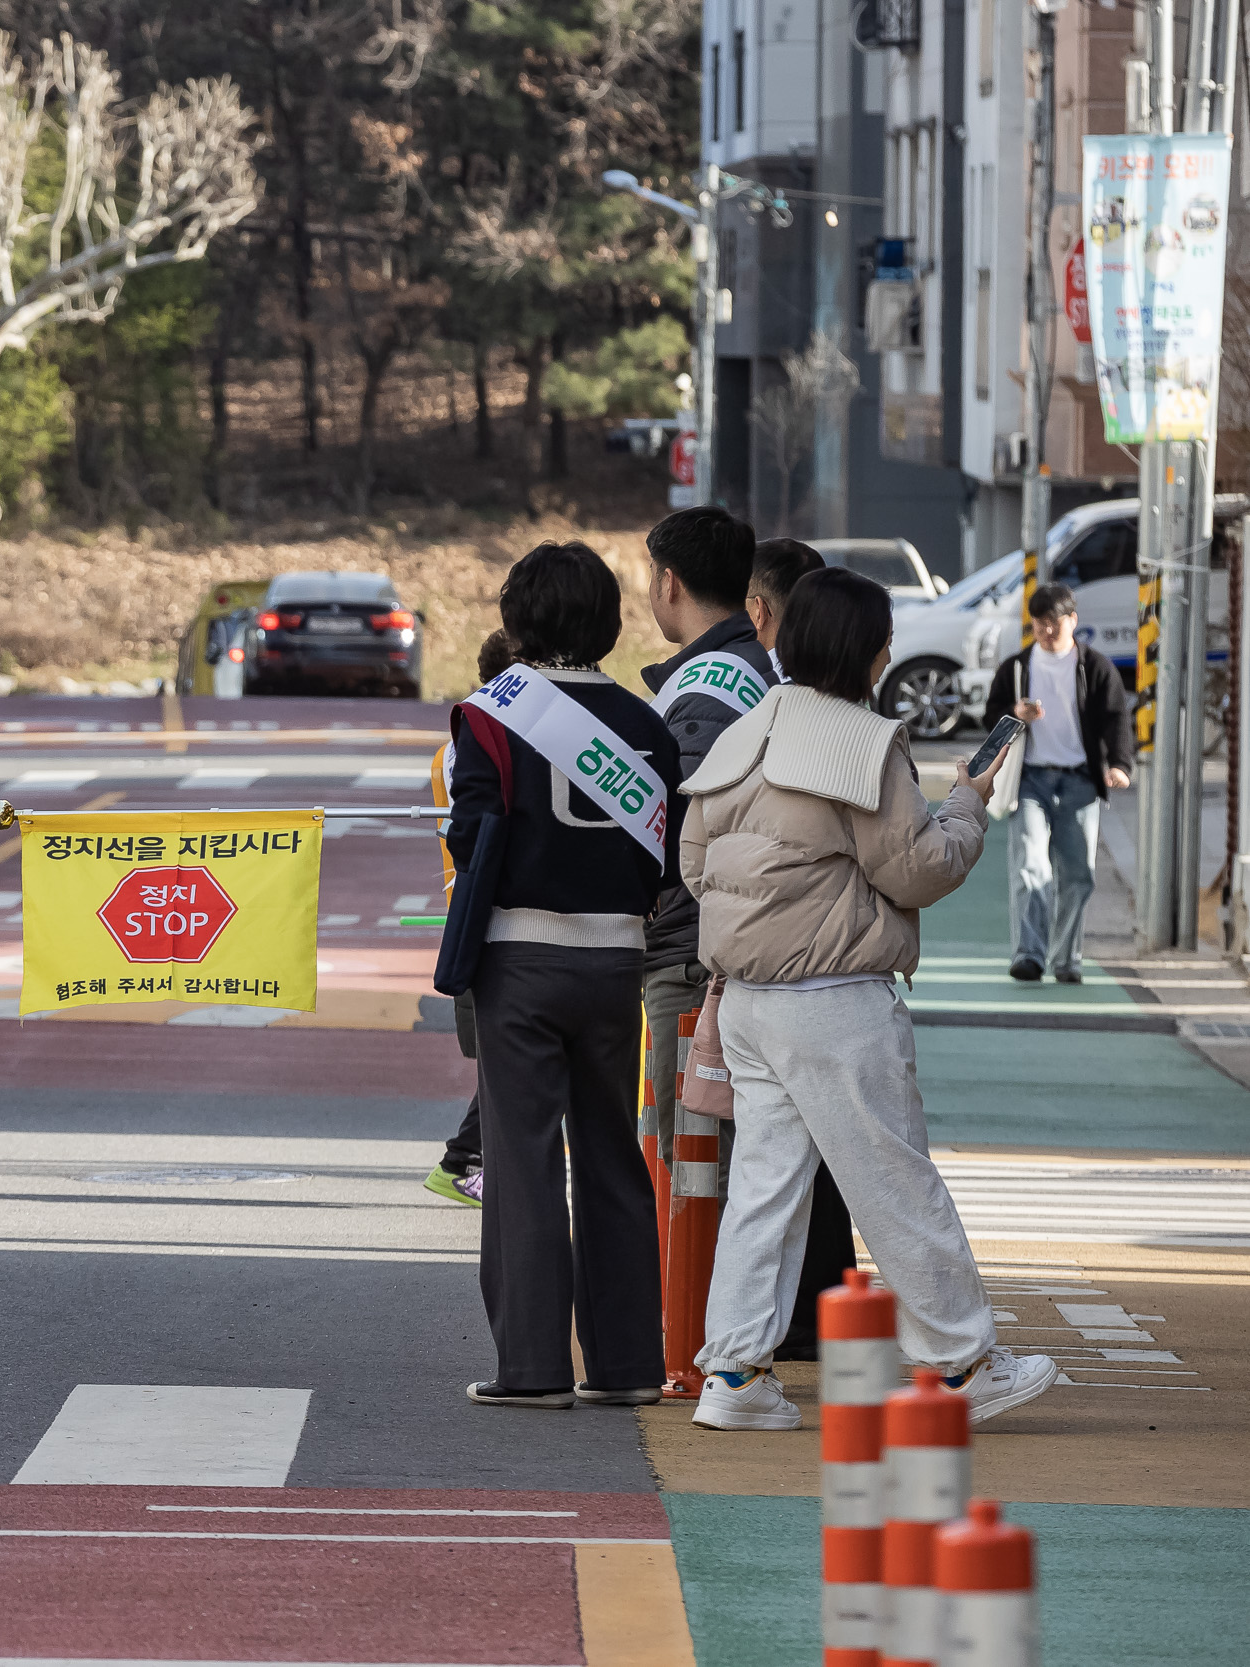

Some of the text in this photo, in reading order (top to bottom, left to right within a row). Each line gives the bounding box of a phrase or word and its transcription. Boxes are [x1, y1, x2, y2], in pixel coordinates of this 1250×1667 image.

[677, 660, 765, 710] 어린이
[575, 736, 655, 815] 어린이
[42, 830, 302, 861] 정지선을 지킵시다
[139, 884, 197, 908] 정지
[125, 912, 209, 937] STOP
[55, 976, 280, 1001] 협조해 주셔서 감사합니다
